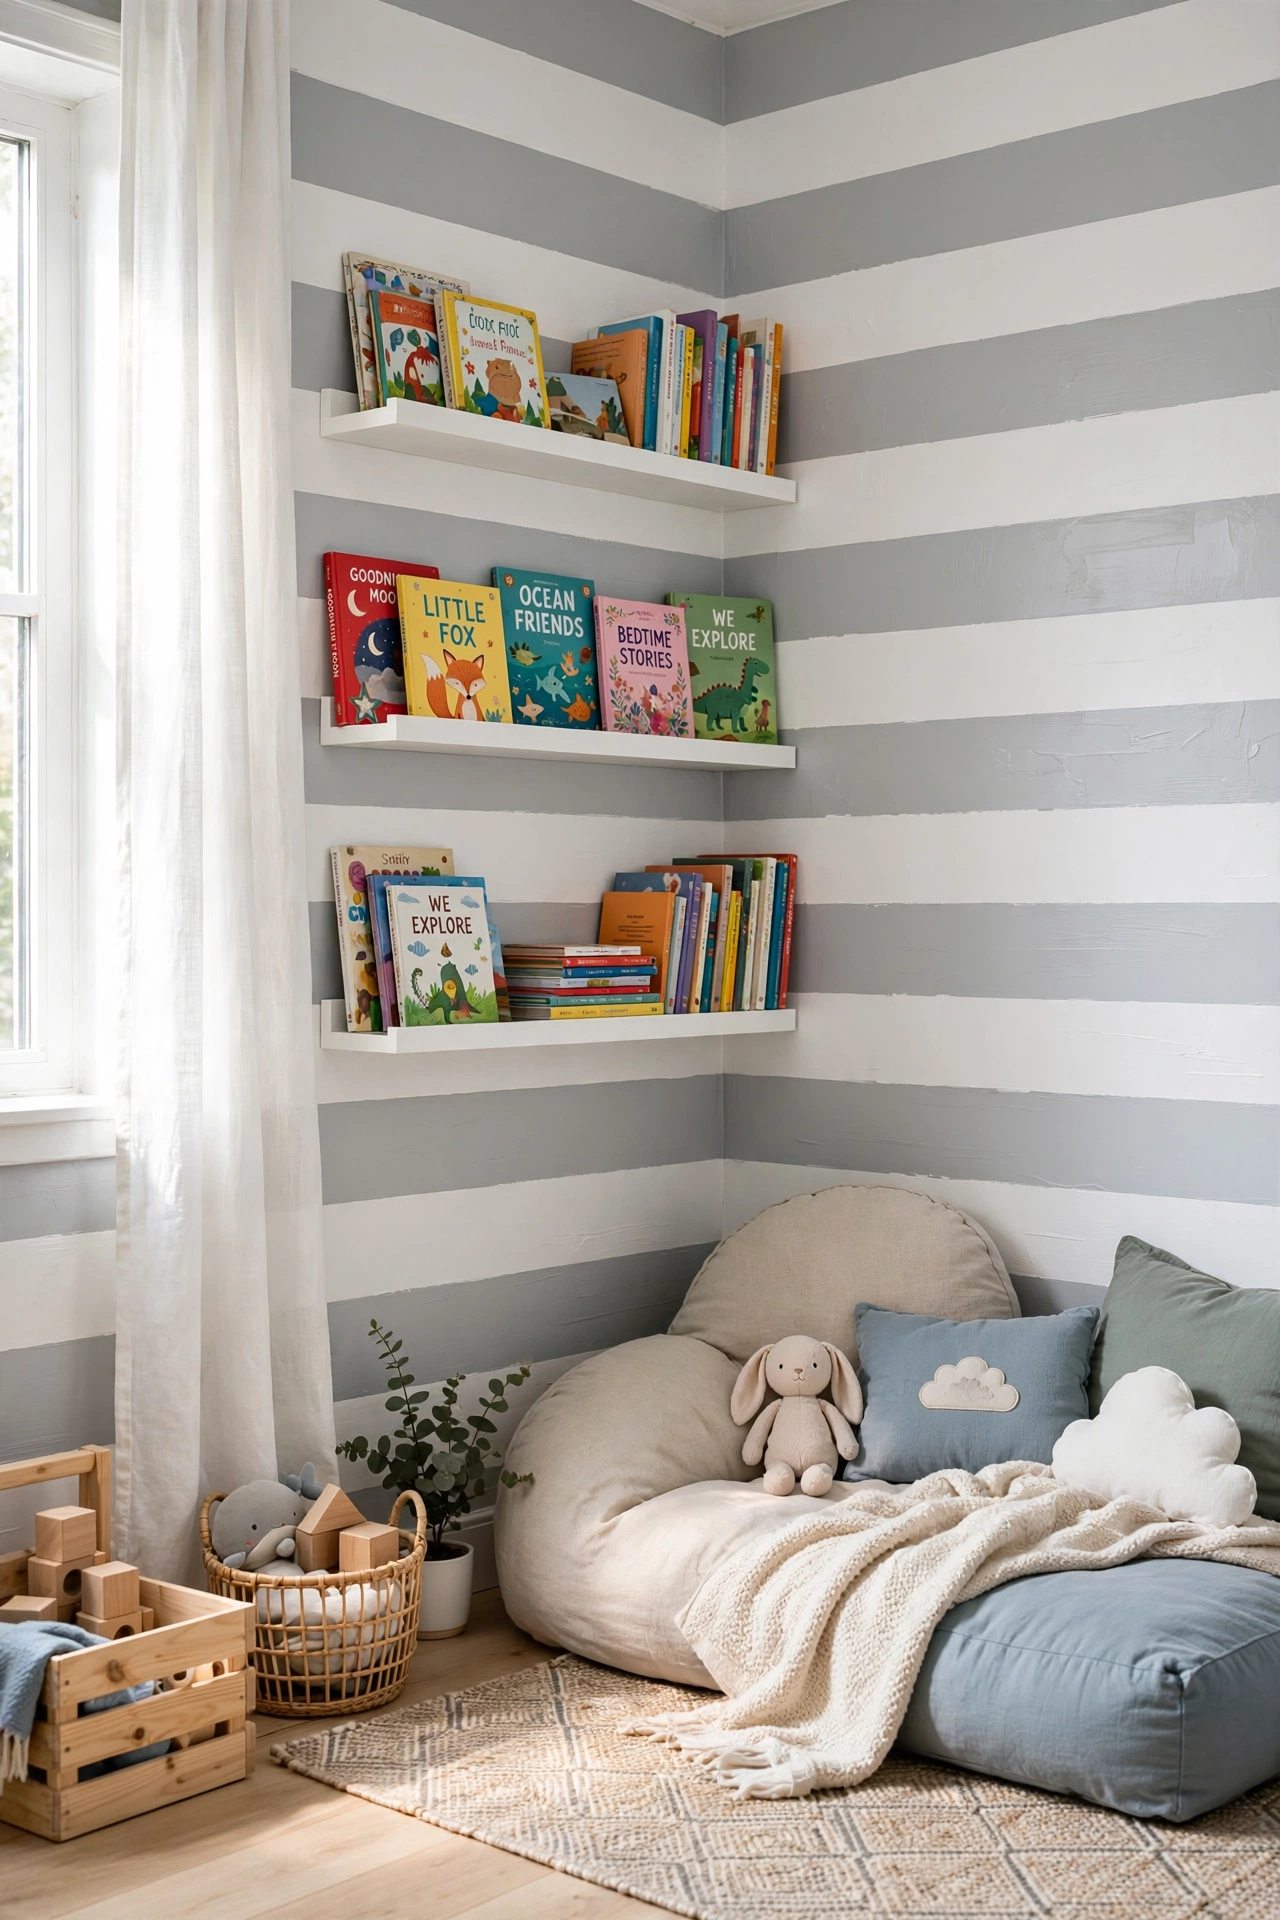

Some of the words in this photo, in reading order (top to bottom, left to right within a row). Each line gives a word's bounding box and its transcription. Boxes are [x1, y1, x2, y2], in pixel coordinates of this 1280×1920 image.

[423, 594, 486, 624] LITTLE
[519, 584, 575, 612] OCEAN
[514, 609, 584, 638] FRIENDS
[712, 608, 735, 628] WE
[439, 623, 477, 648] FOX
[617, 625, 672, 649] BEDTIME
[691, 628, 757, 651] EXPLORE
[619, 648, 673, 669] STORIES
[428, 895, 452, 912] WE
[411, 916, 473, 934] EXPLORE
